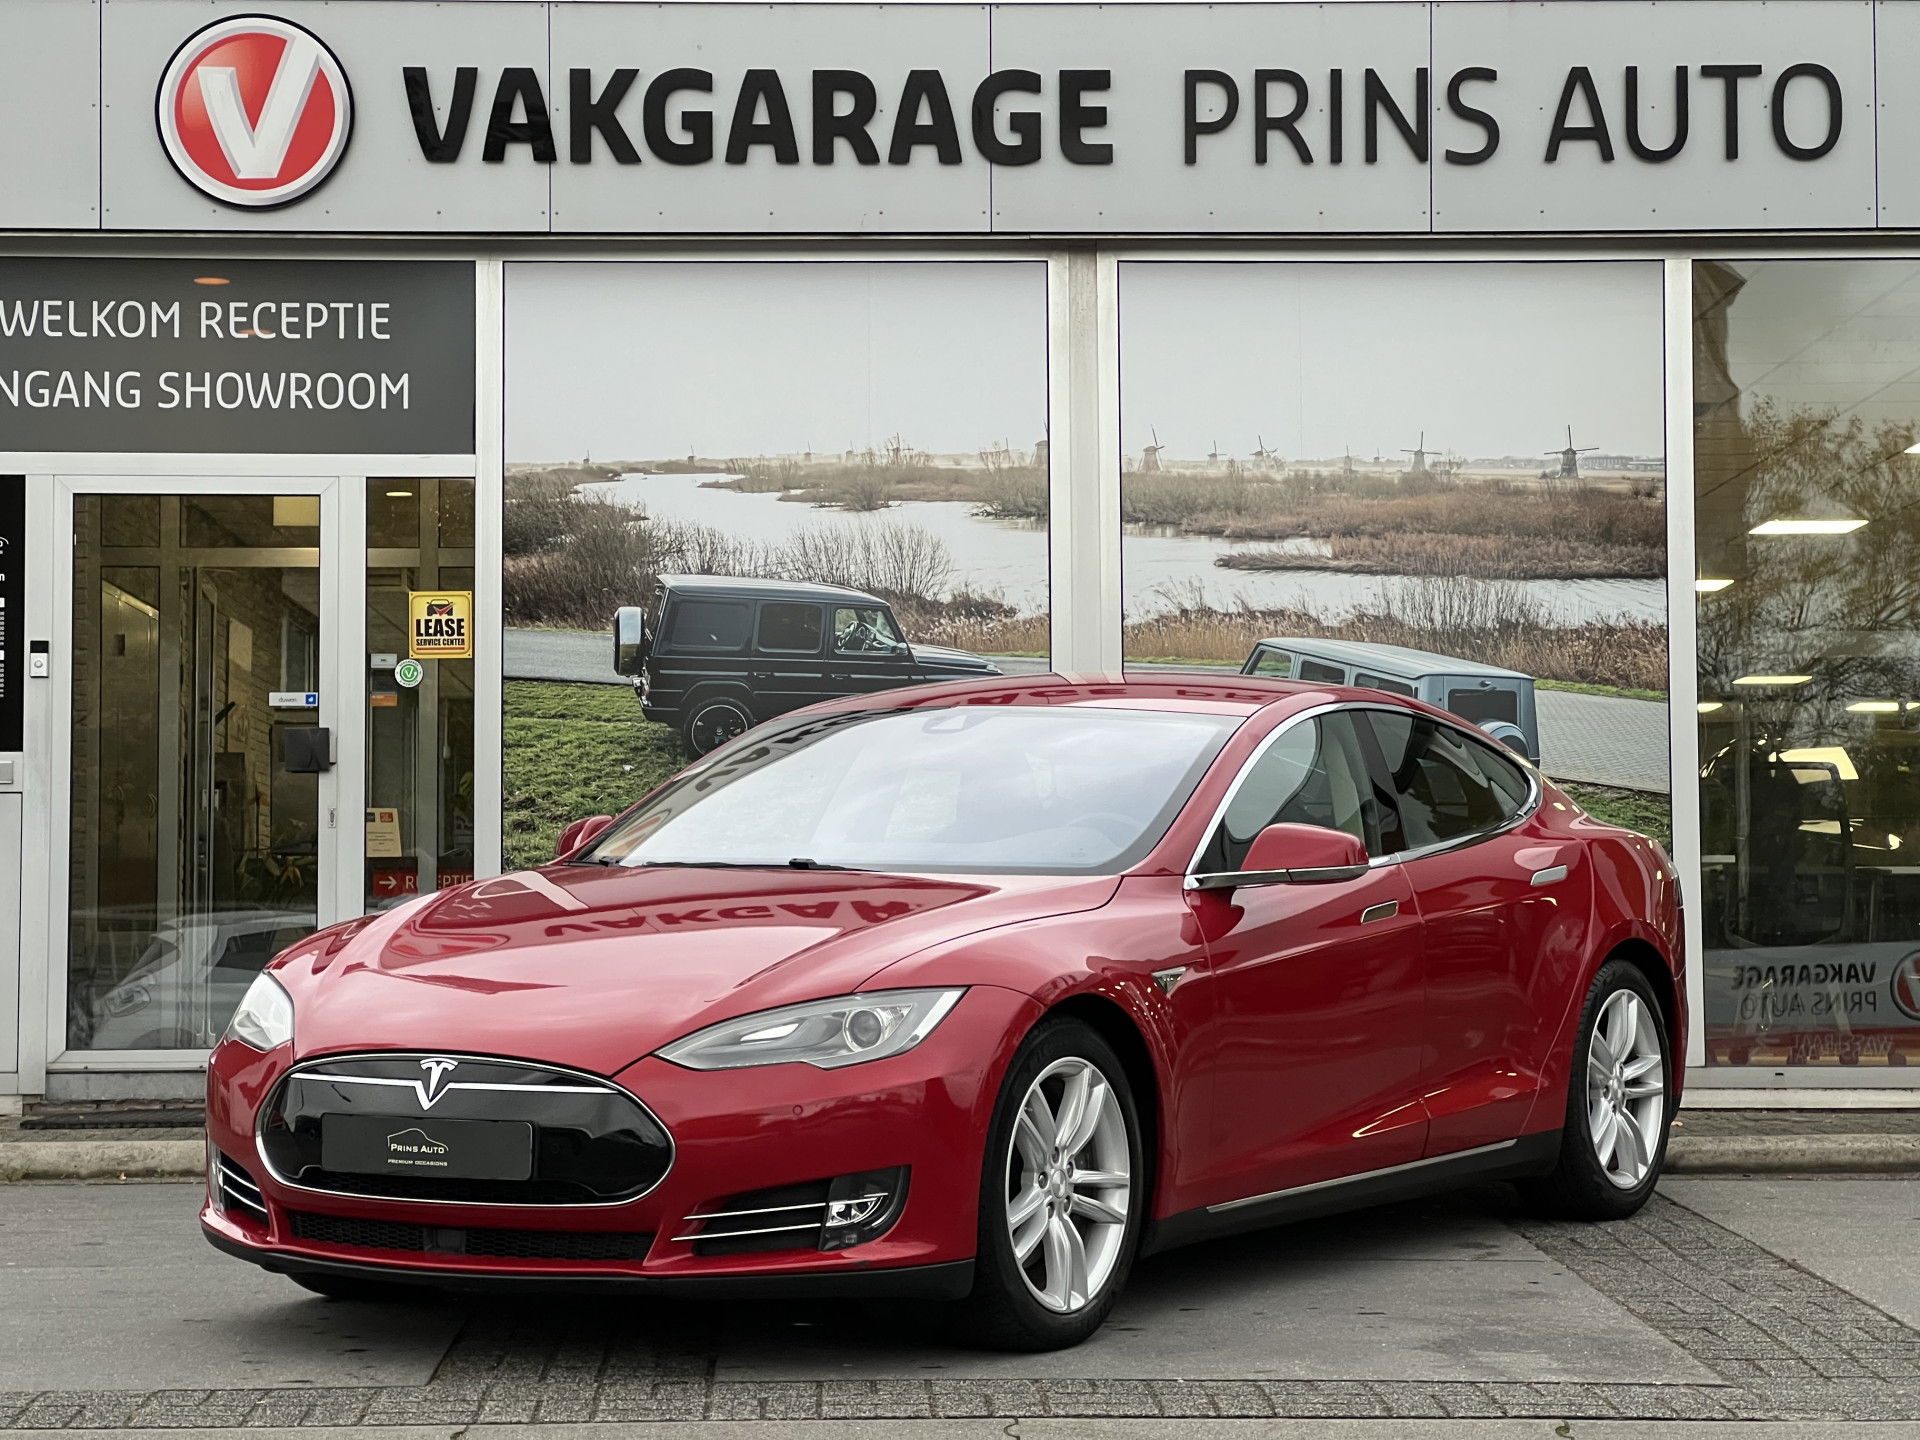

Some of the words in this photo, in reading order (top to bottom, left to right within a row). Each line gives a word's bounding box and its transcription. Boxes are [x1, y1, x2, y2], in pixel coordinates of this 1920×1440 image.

[403, 67, 1114, 166] VAKGARAGE
[1184, 67, 1500, 166] PRINS
[1545, 63, 1843, 162] AUTO
[0, 300, 180, 338] WELKOM
[200, 302, 391, 340] RECEPTIE
[157, 371, 409, 410] SHOWROOM
[415, 618, 465, 637] LEASE
[415, 638, 441, 647] SERVICE
[442, 637, 466, 646] CENTER
[390, 1143, 419, 1153] PRINS
[420, 1145, 445, 1154] AUTO
